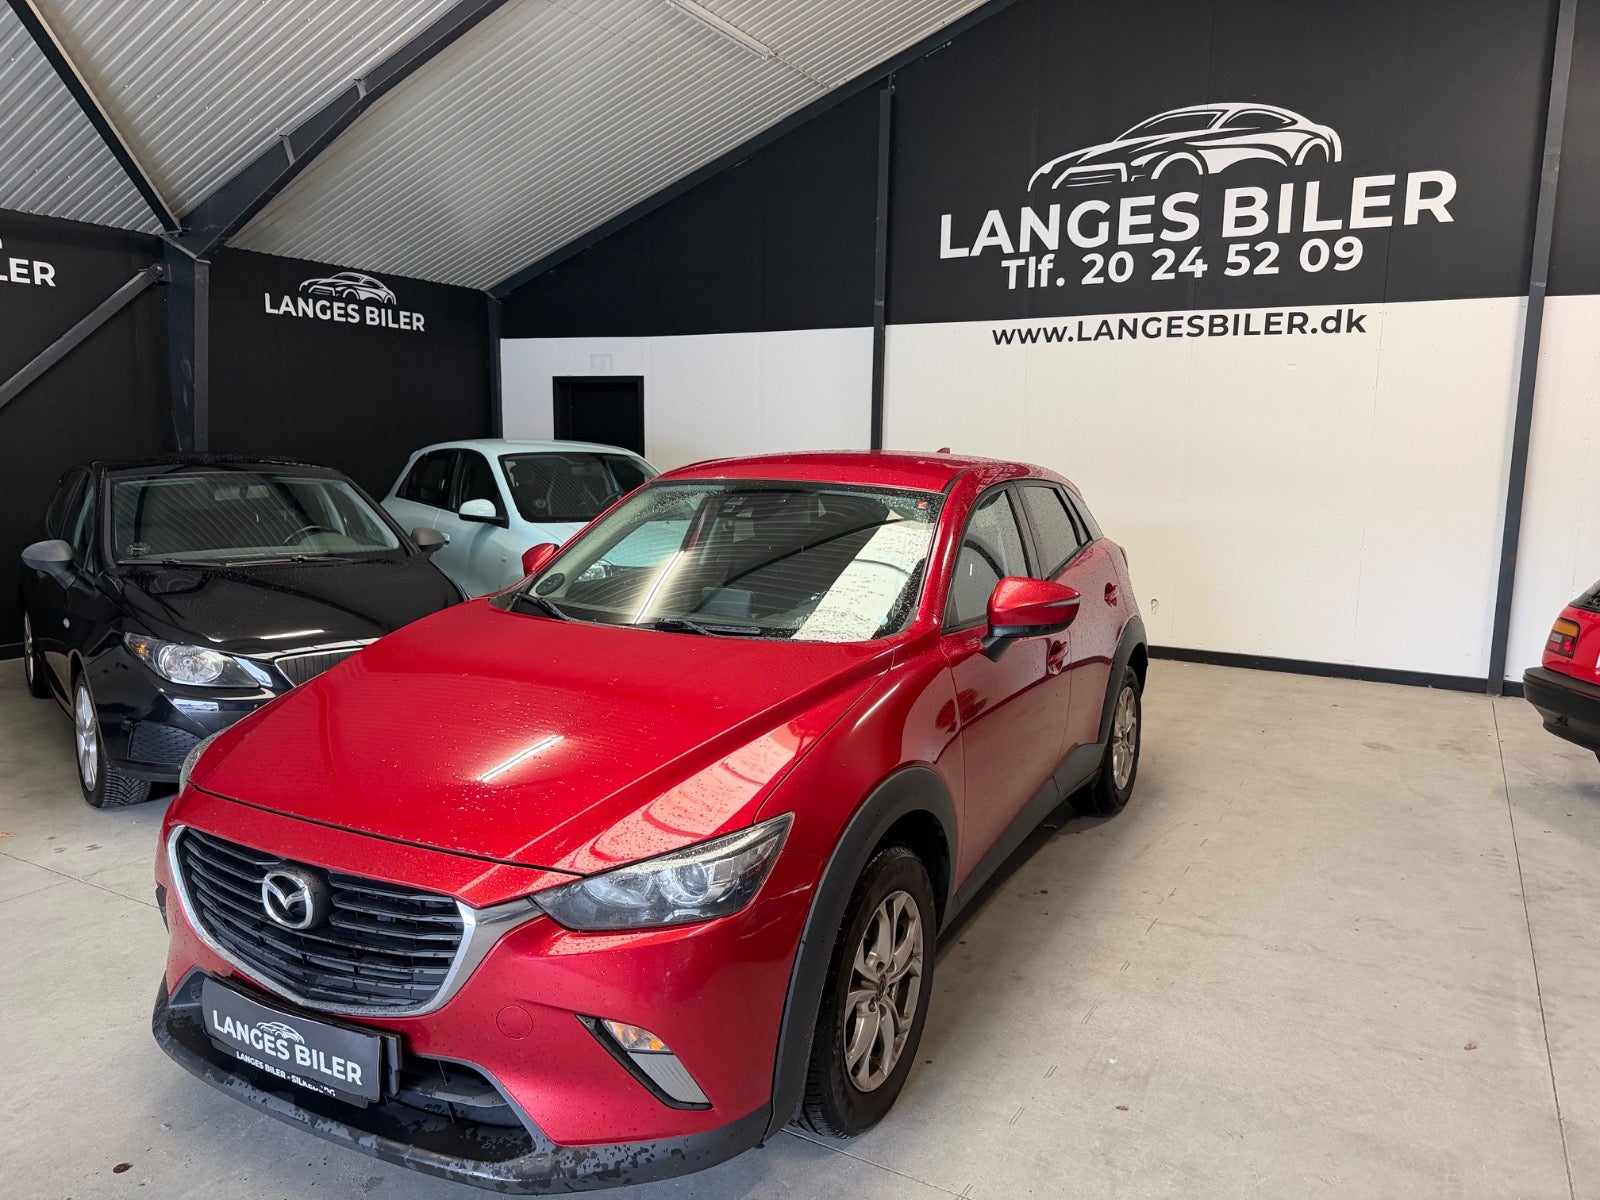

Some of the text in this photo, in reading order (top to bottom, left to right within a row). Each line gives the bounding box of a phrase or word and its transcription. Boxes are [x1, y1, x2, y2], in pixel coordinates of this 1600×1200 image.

[940, 170, 1457, 260] LANGES BILER
[1001, 236, 1364, 290] Tlf. 20 24 52 09
[264, 292, 425, 332] LANGES BILER
[992, 309, 1368, 346] www.LANGESBILER.dk
[213, 1010, 363, 1086] LANGES BILER
[236, 1051, 264, 1070] LANGES
[264, 1063, 286, 1080] BILER
